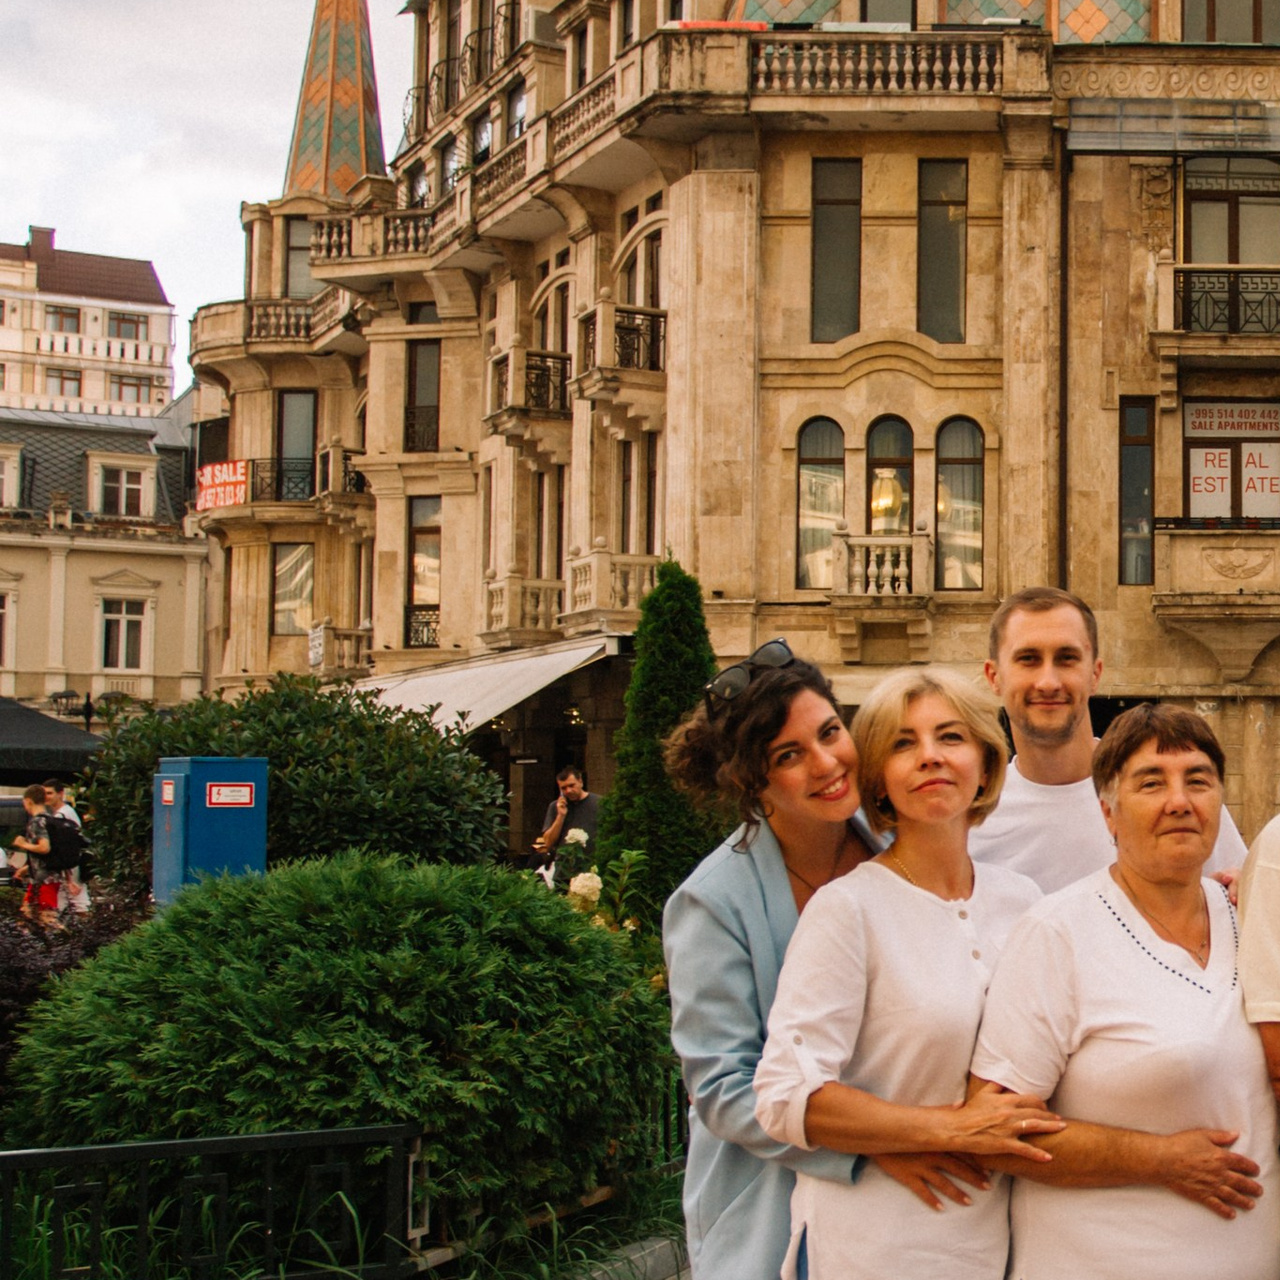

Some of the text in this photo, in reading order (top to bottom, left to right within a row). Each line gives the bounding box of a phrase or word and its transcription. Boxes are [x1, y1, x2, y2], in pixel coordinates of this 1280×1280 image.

[1217, 409, 1235, 419] 514
[1237, 409, 1257, 420] 402
[1260, 409, 1279, 420] 442
[1191, 421, 1280, 432] SALE APARTMENTS
[214, 461, 246, 484] SALE
